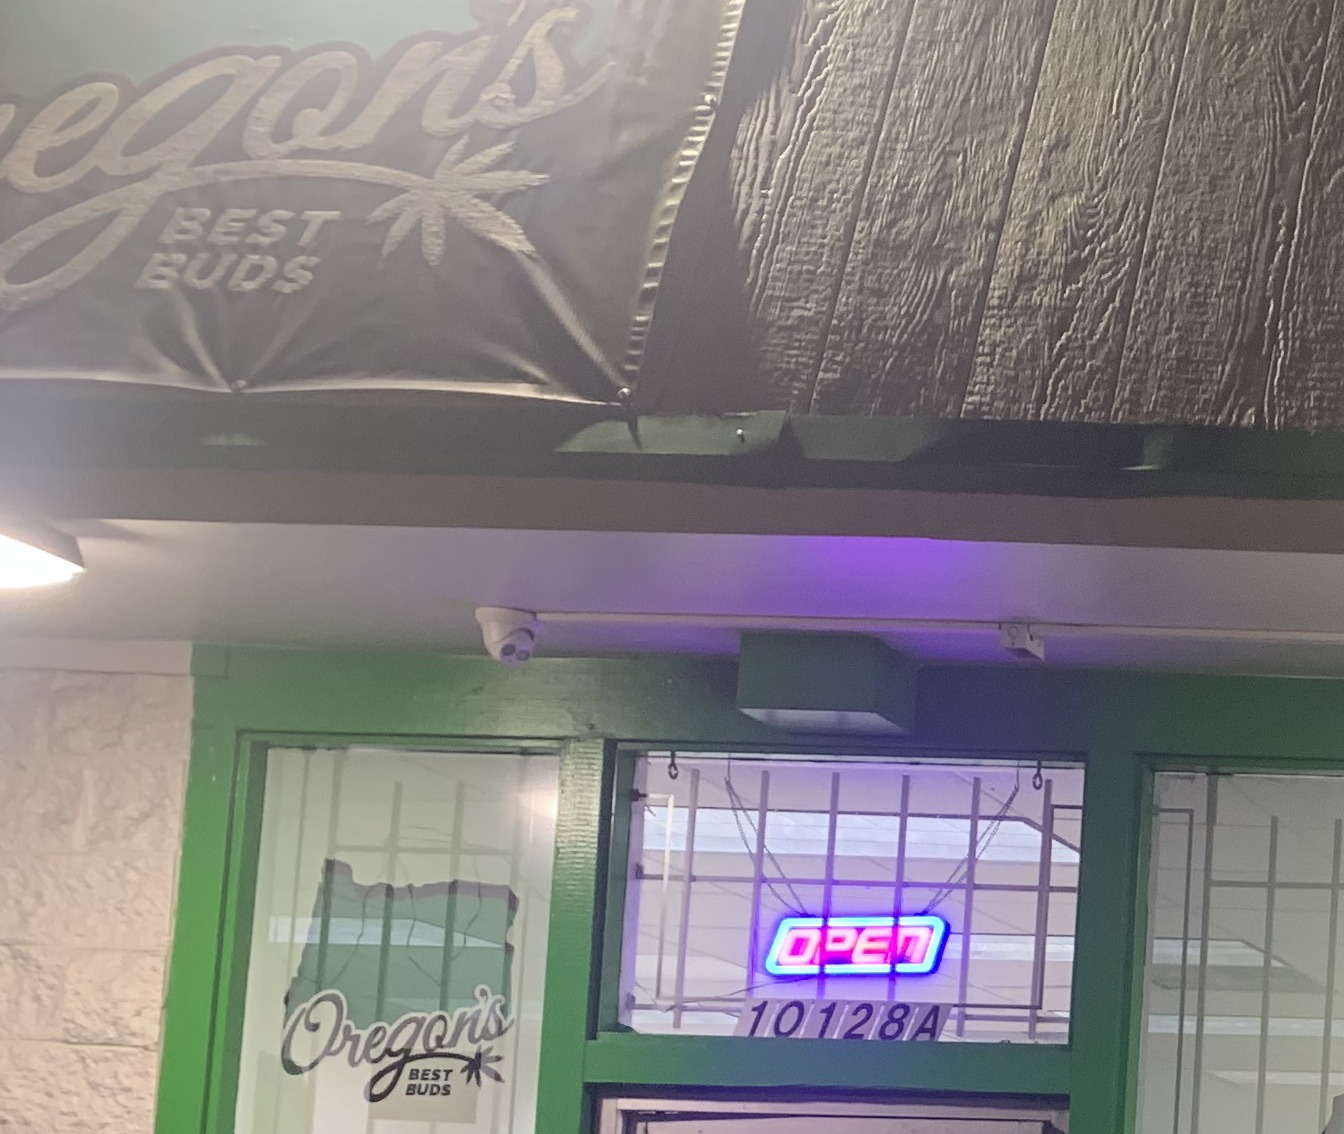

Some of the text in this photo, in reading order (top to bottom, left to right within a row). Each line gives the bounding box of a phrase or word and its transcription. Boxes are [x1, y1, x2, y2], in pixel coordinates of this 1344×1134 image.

[158, 207, 341, 246] BEST
[134, 252, 321, 291] BUDS
[778, 925, 934, 966] OPEN
[747, 1000, 942, 1041] 10128A
[281, 988, 514, 1103] Oregon's
[405, 1083, 452, 1097] BUDS
[409, 1068, 454, 1081] BEST
